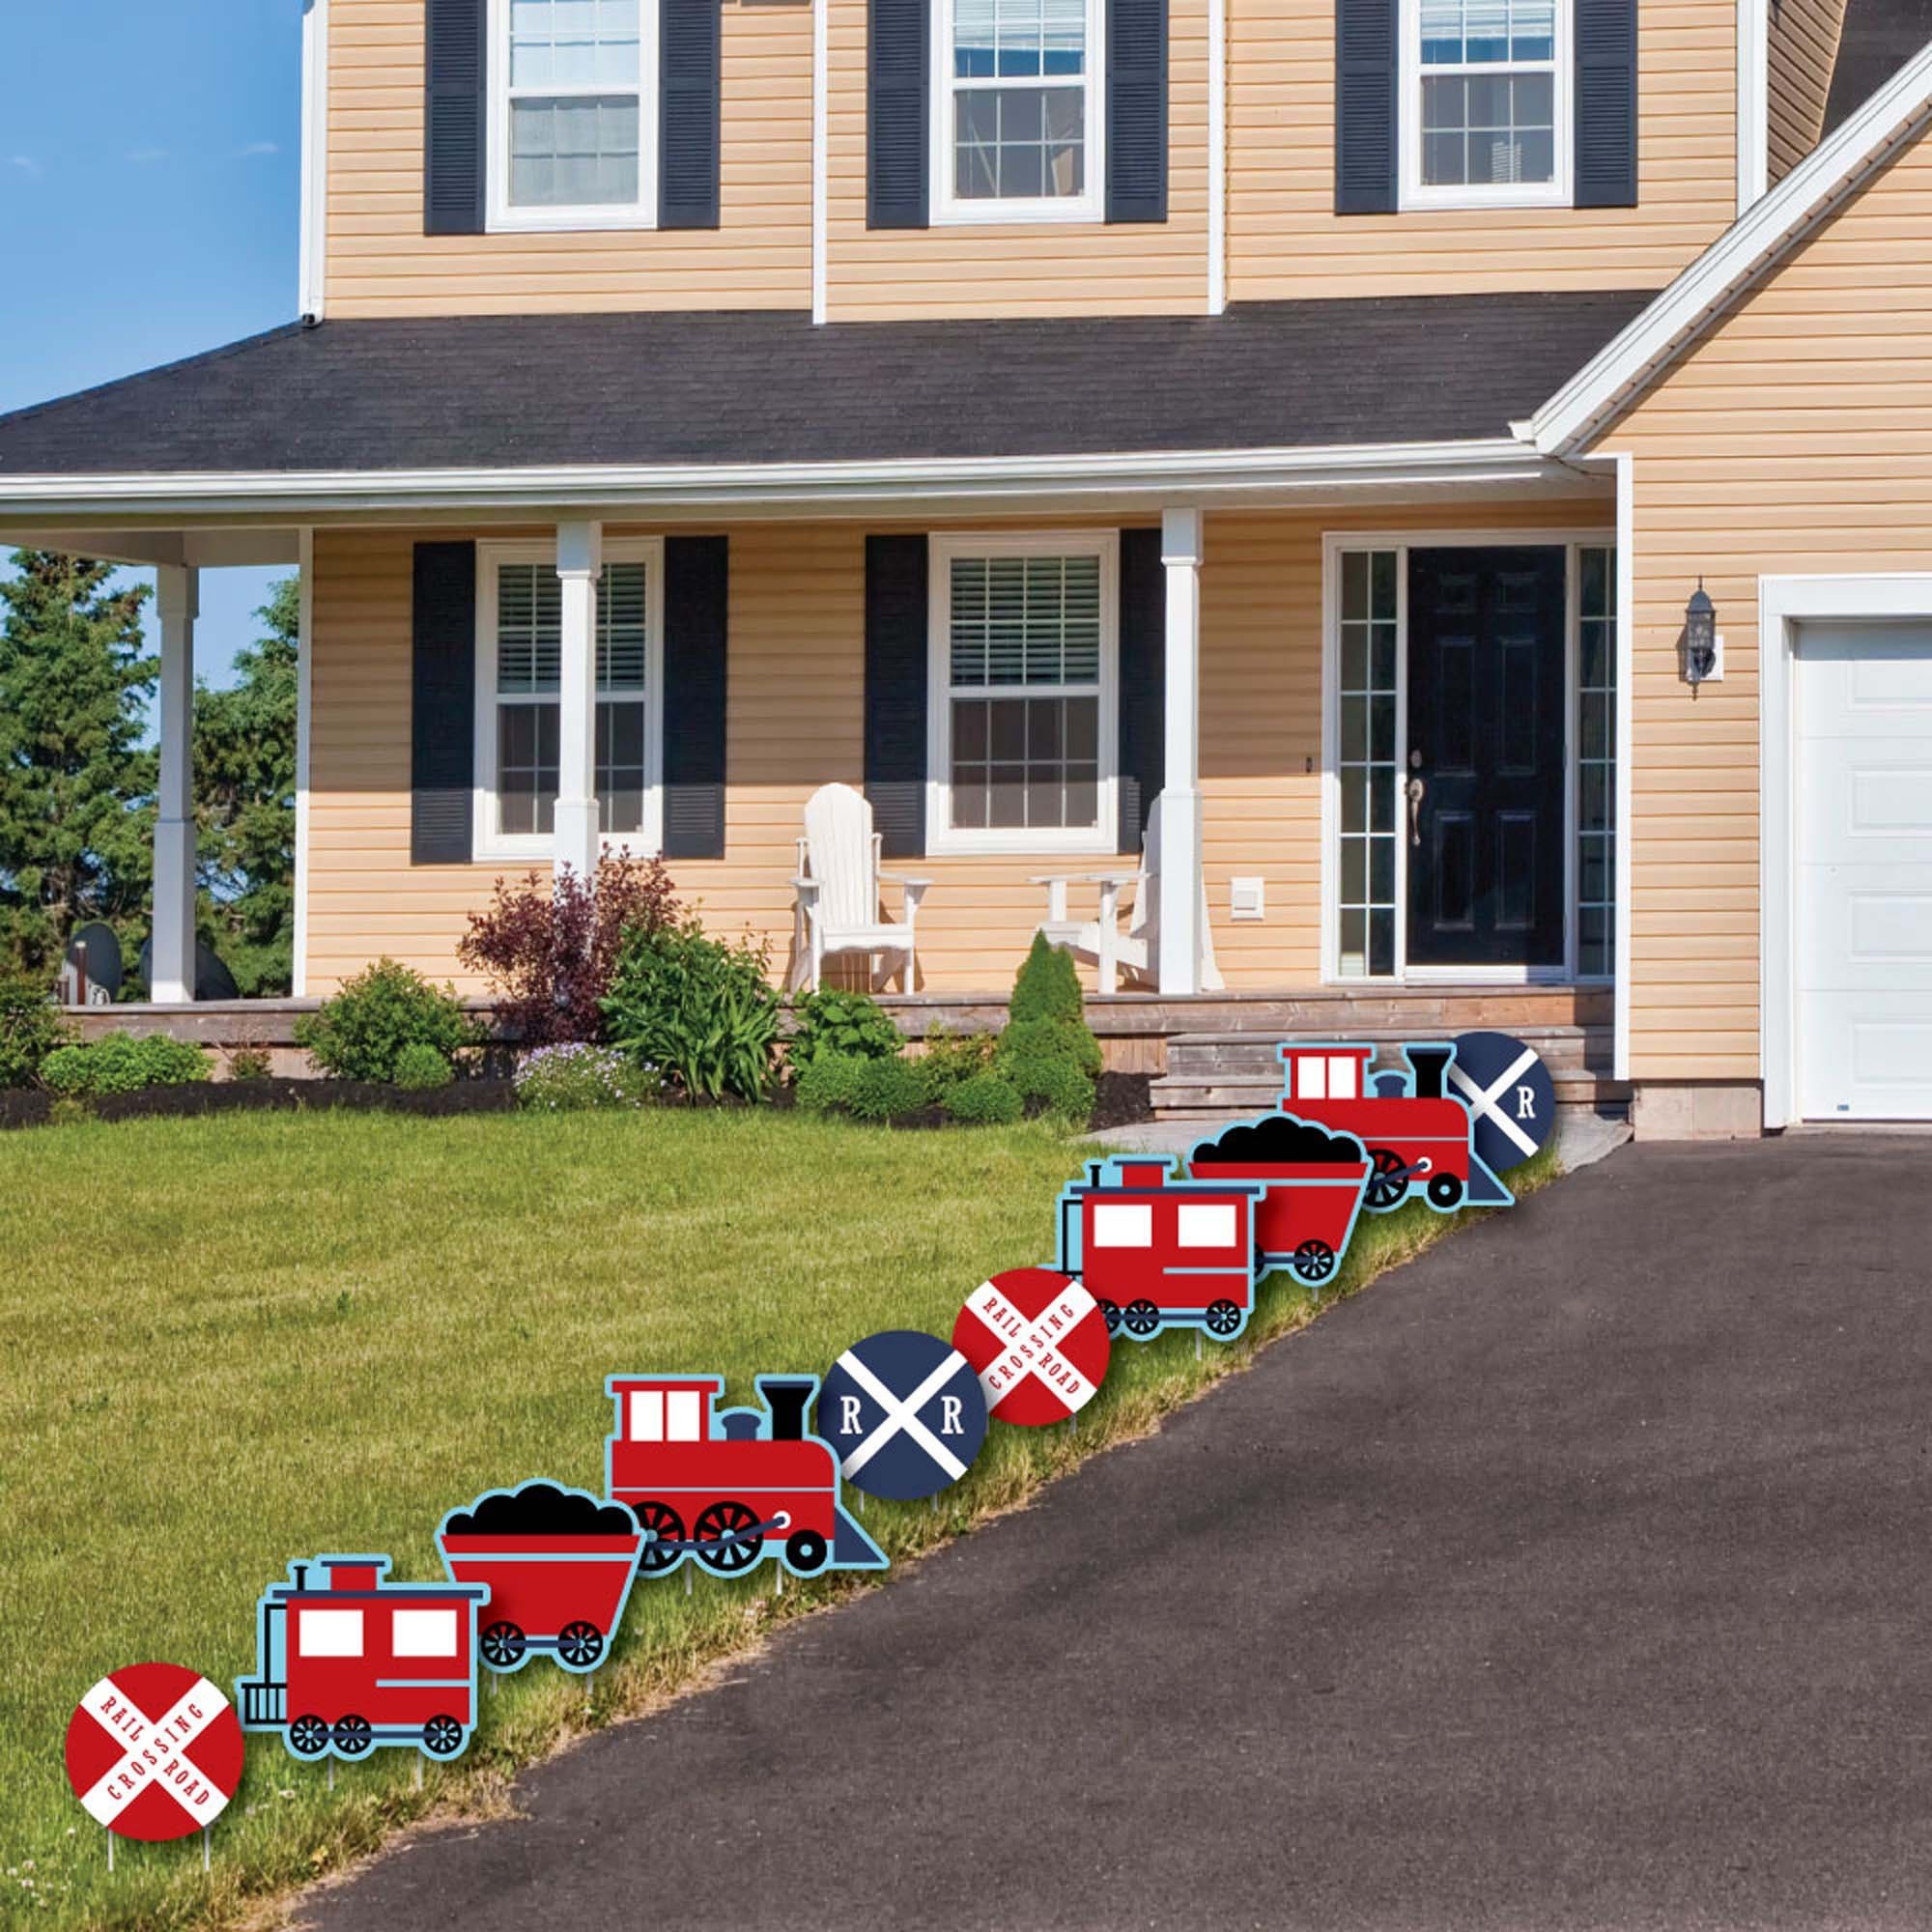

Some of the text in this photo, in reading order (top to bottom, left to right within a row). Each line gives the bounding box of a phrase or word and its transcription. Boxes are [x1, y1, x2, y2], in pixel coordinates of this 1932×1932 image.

[1517, 1086, 1536, 1119] R
[982, 1297, 1080, 1394] RAIL ROAD
[988, 1304, 1074, 1389] CROSSING
[839, 1396, 964, 1435] R R
[100, 1696, 210, 1804] RAIL ROAD
[107, 1703, 203, 1800] CROSSING
